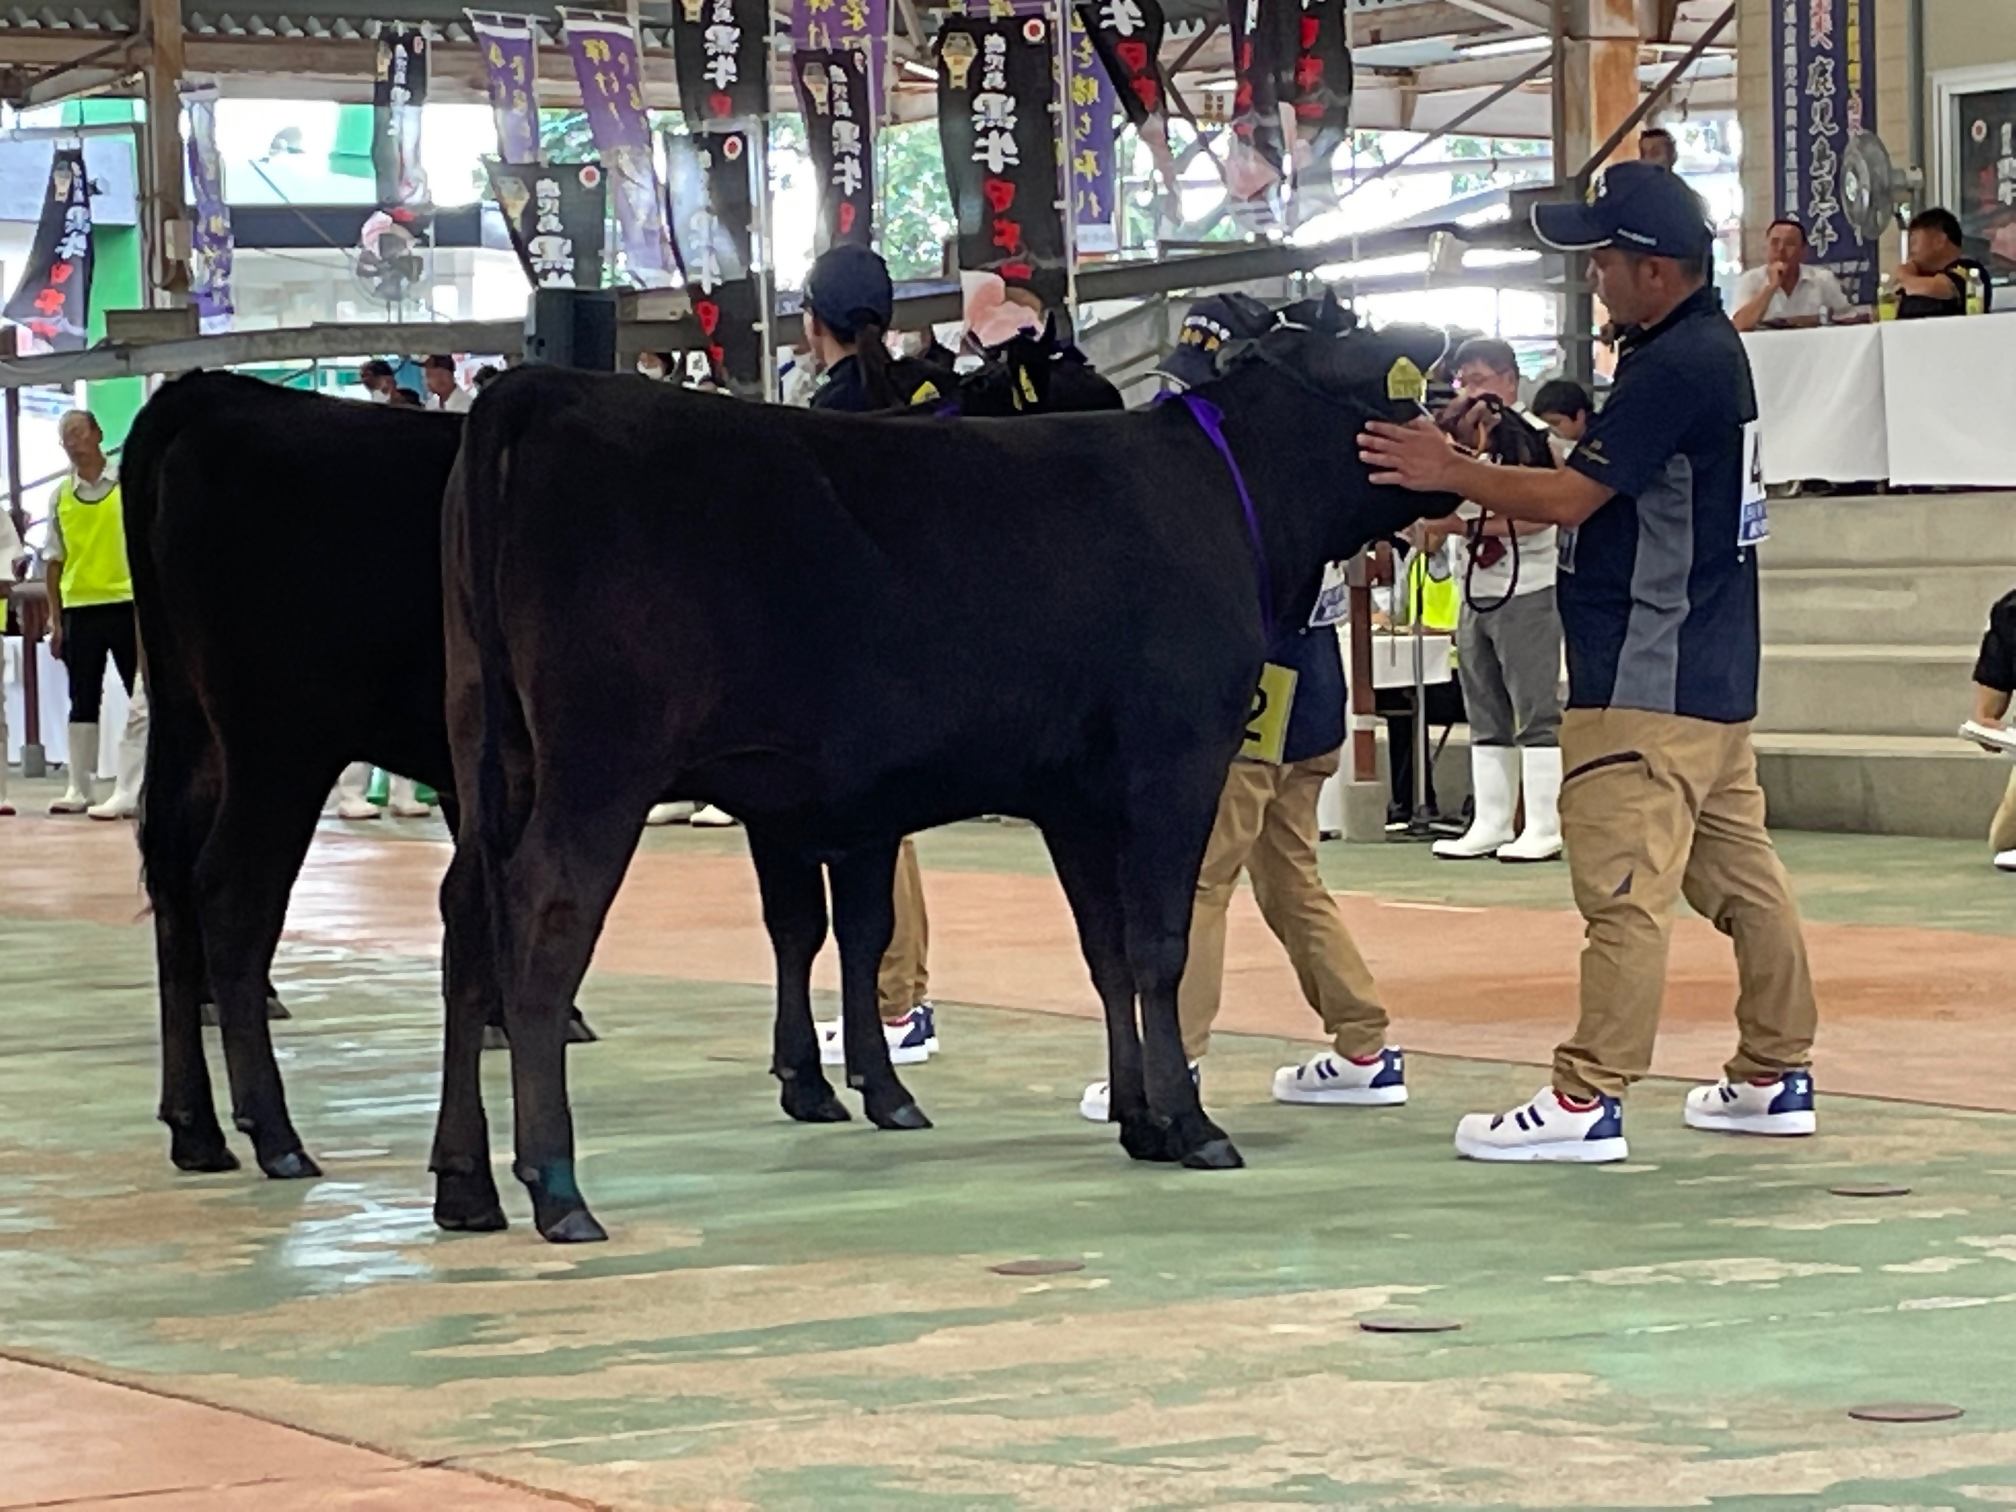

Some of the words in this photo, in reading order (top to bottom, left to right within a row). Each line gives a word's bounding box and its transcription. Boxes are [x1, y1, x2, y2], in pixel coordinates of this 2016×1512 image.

[971, 33, 1020, 173] 鹿児島黒牛
[1804, 55, 1840, 258] 鹿児島黒牛
